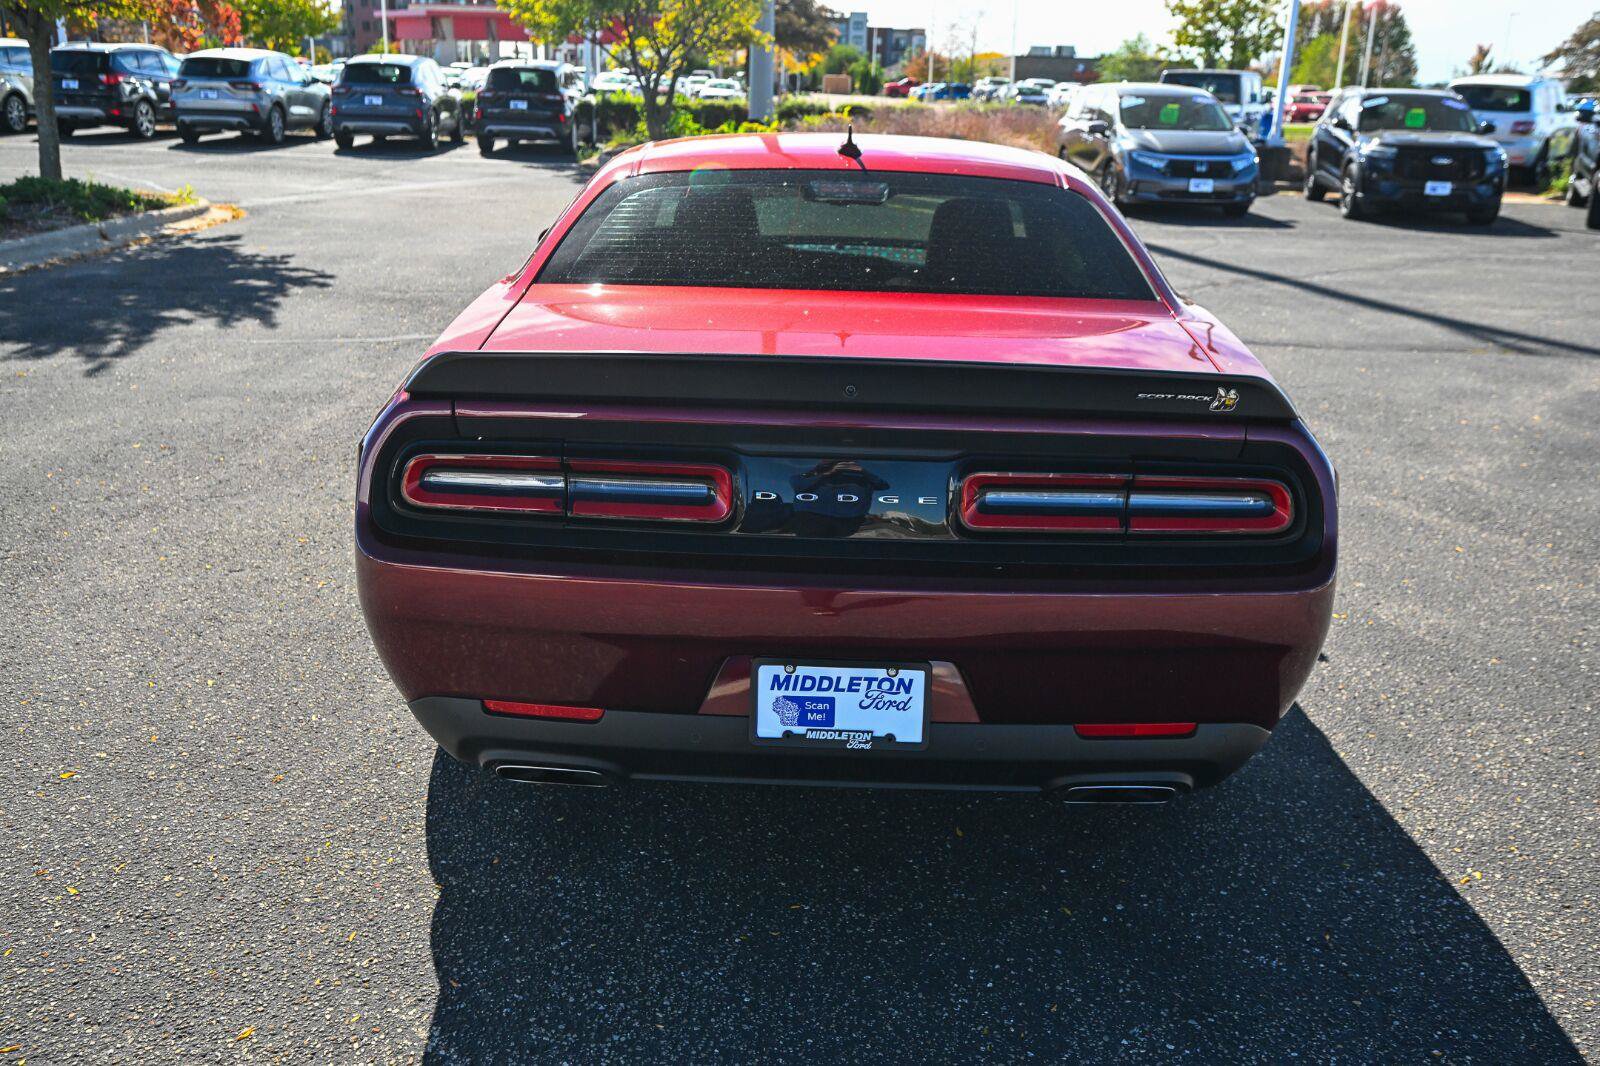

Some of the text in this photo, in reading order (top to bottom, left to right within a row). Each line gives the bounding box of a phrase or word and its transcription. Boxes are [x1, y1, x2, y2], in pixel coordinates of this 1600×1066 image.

[755, 491, 938, 505] DODGE
[770, 674, 914, 695] MIDDLETON
[804, 701, 830, 710] Scan
[859, 689, 913, 712] Ford
[807, 712, 826, 721] Me!
[806, 729, 872, 741] MIDDLETON
[846, 739, 873, 750] Ford
